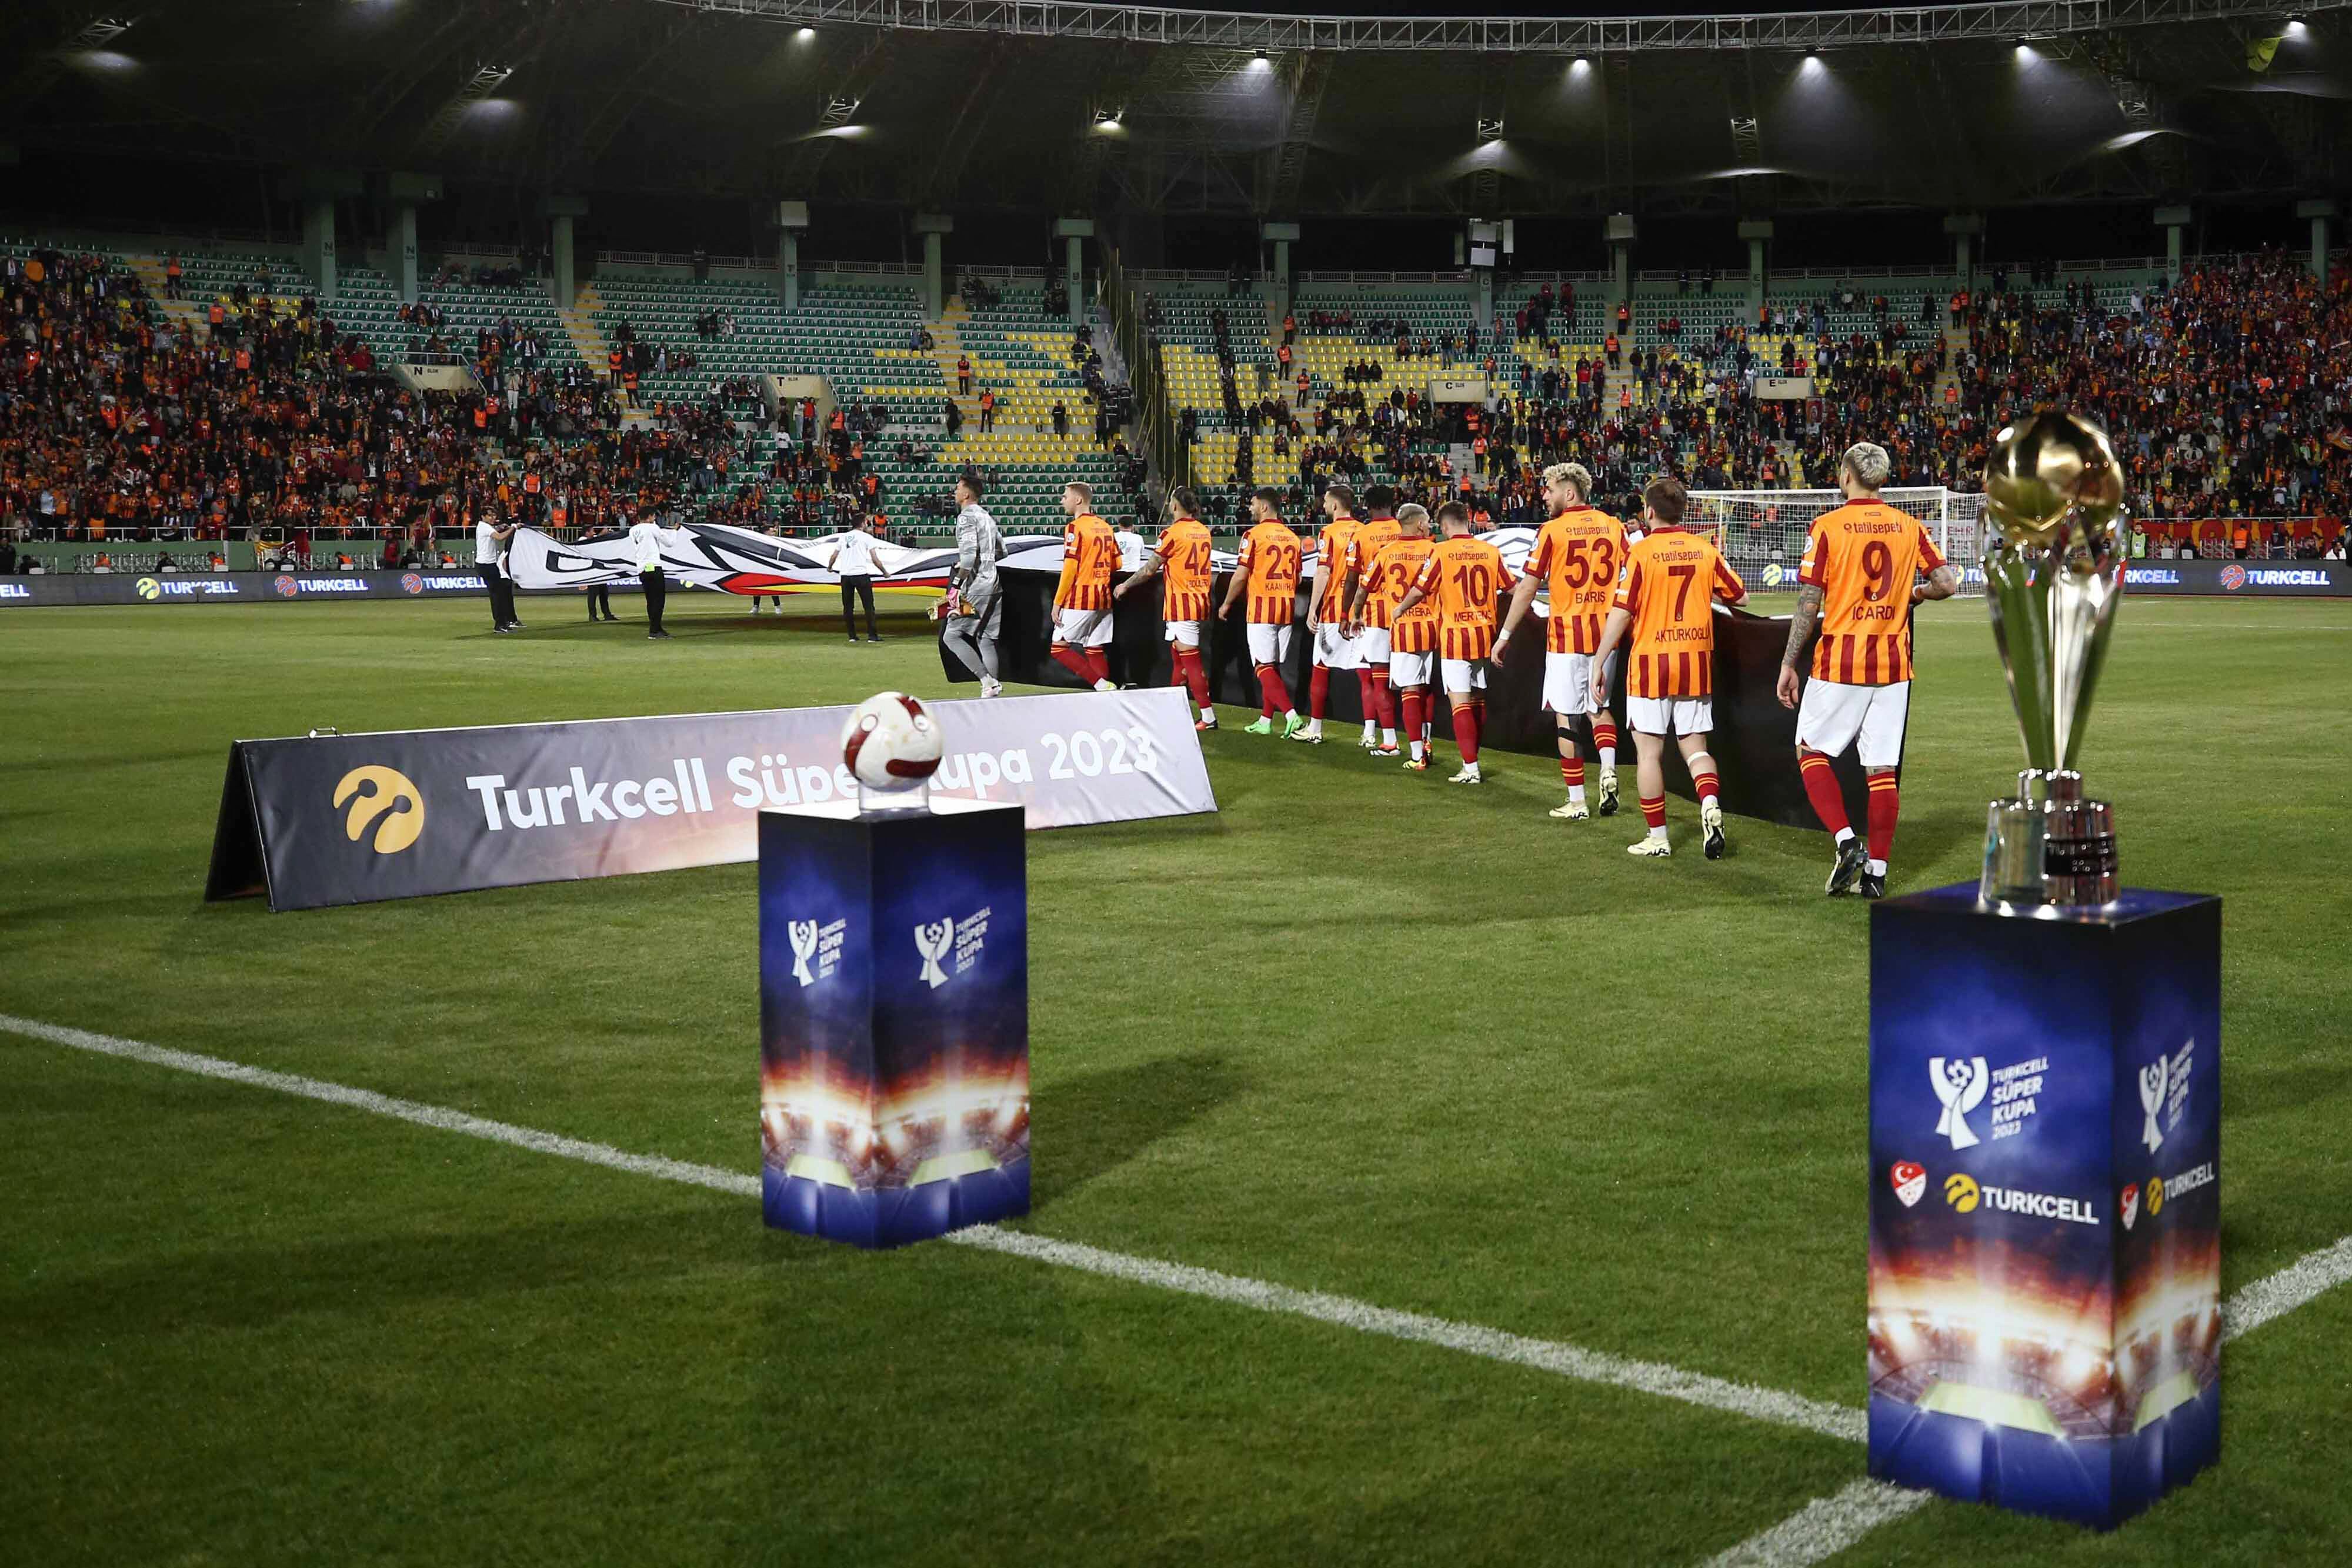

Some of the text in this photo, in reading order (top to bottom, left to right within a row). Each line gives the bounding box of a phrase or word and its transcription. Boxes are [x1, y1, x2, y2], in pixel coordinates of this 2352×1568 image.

[414, 367, 422, 375] N
[777, 376, 785, 386] T
[1185, 541, 1210, 576] 42
[1266, 545, 1296, 580] 23
[1564, 538, 1614, 589] 53
[1862, 541, 1893, 602] 9
[298, 579, 368, 592] TURKCELL
[423, 576, 487, 589] TURKCELL
[1453, 565, 1489, 608] 10
[2123, 569, 2179, 583] RKCELL
[2248, 569, 2330, 586] TURKCELL
[1576, 591, 1606, 604] BARIŞ
[1668, 565, 1696, 622] 7
[1853, 605, 1896, 620] ICARDI
[465, 727, 1159, 832] Turkcell Süpe upa 2023
[1991, 1056, 2049, 1084] TURKCELL
[1991, 1076, 2043, 1105] SÜPER
[1991, 1097, 2037, 1125] KUPA
[2164, 1162, 2216, 1202] TURKCELL
[1980, 1186, 2100, 1225] TURKCELL
